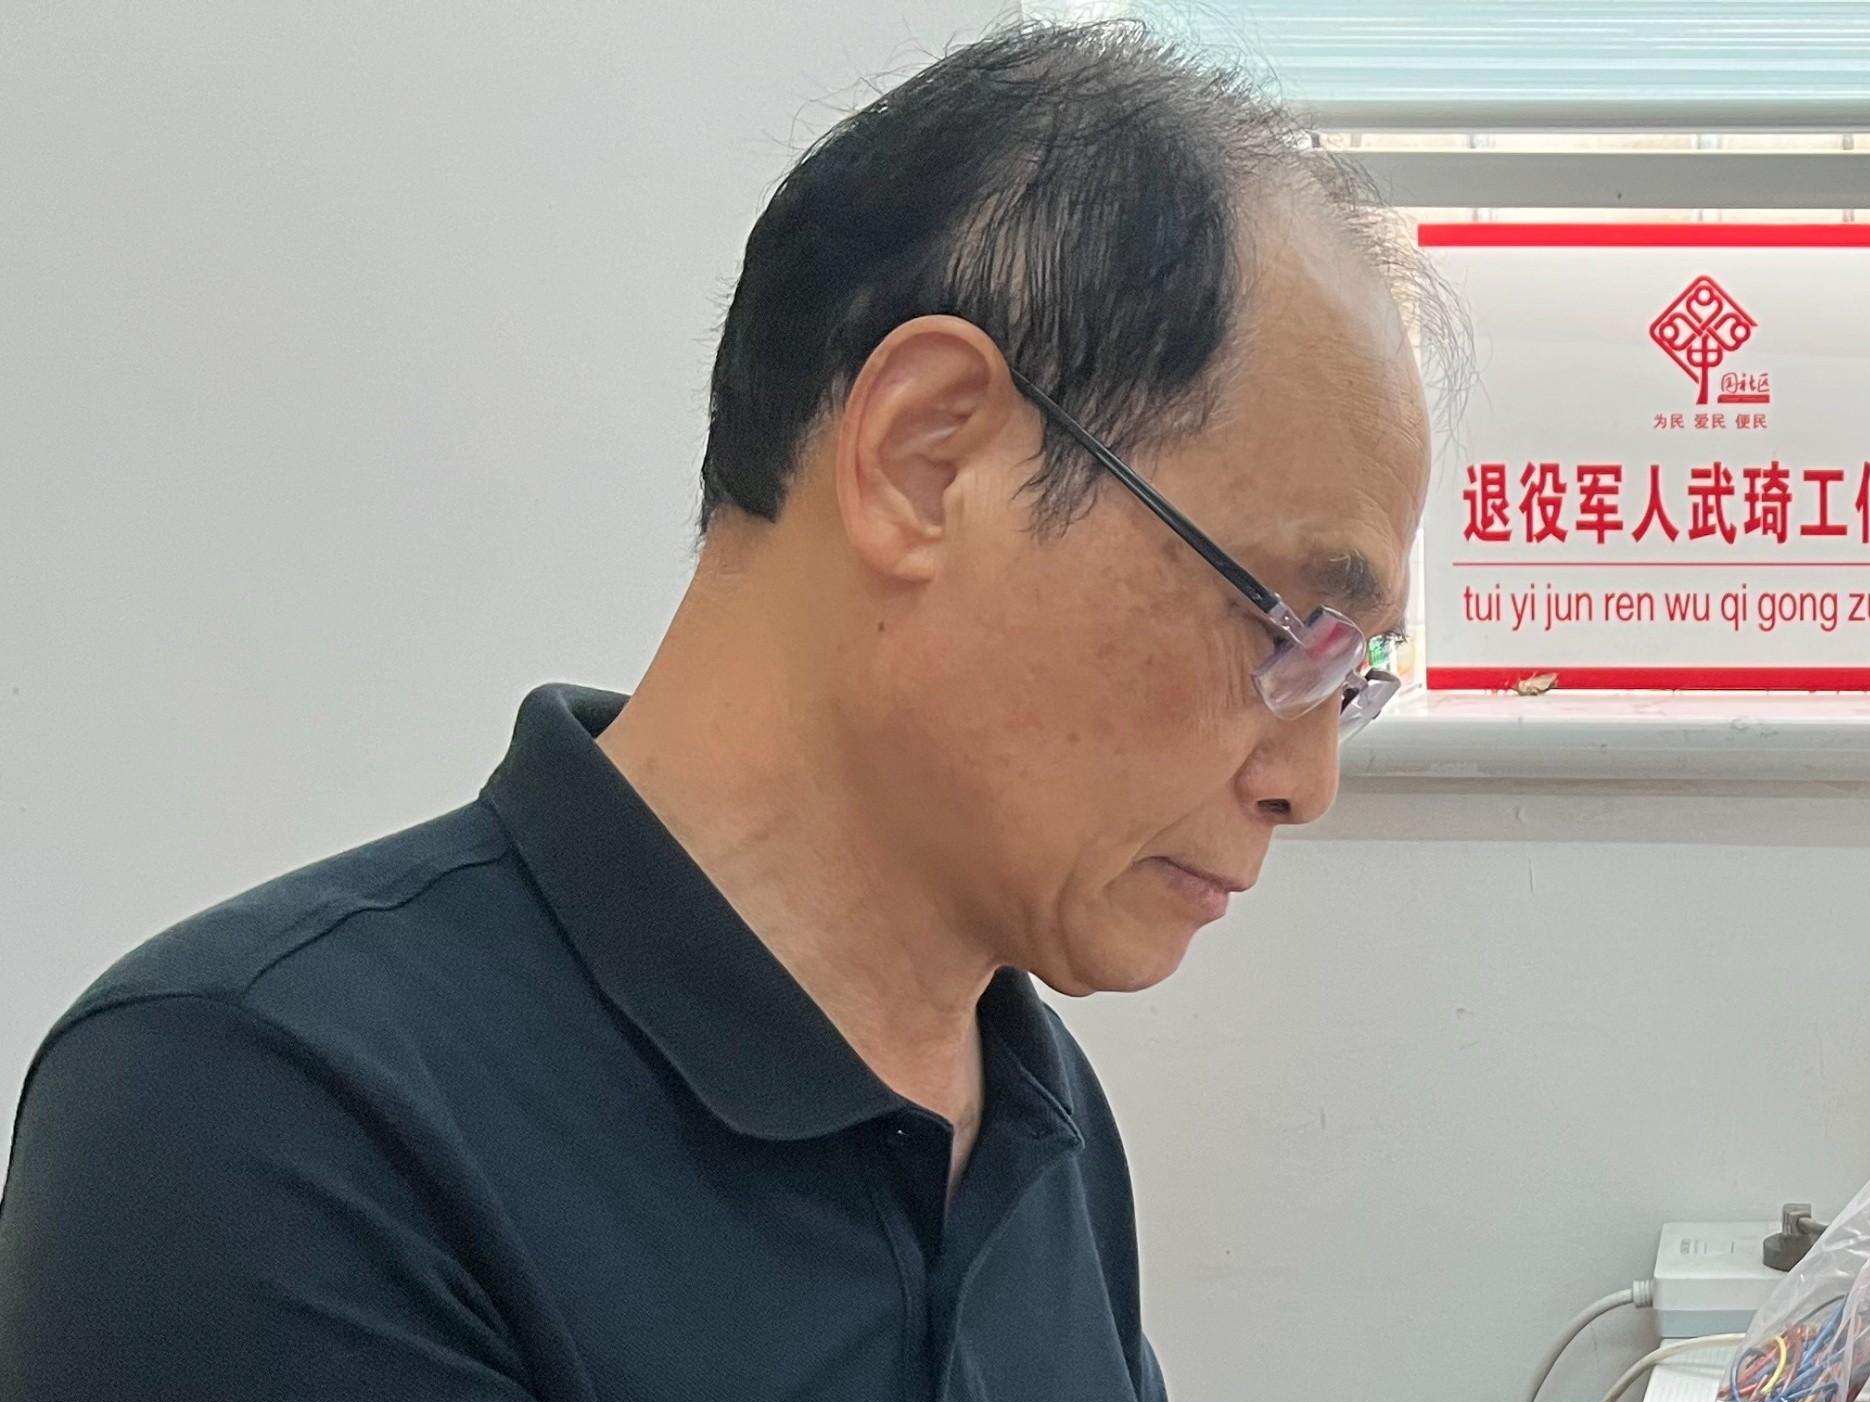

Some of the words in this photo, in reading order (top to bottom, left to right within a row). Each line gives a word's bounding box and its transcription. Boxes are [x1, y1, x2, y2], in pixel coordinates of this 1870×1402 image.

[1653, 413, 1685, 430] 为民
[1694, 413, 1726, 430] 爱民
[1735, 413, 1768, 430] 便民
[1463, 584, 1502, 622] tui
[1511, 584, 1536, 631] yi
[1544, 584, 1594, 631] jun
[1603, 591, 1656, 622] ren
[1665, 592, 1711, 622] wu
[1720, 584, 1748, 631] qi
[1757, 591, 1839, 632] gong
